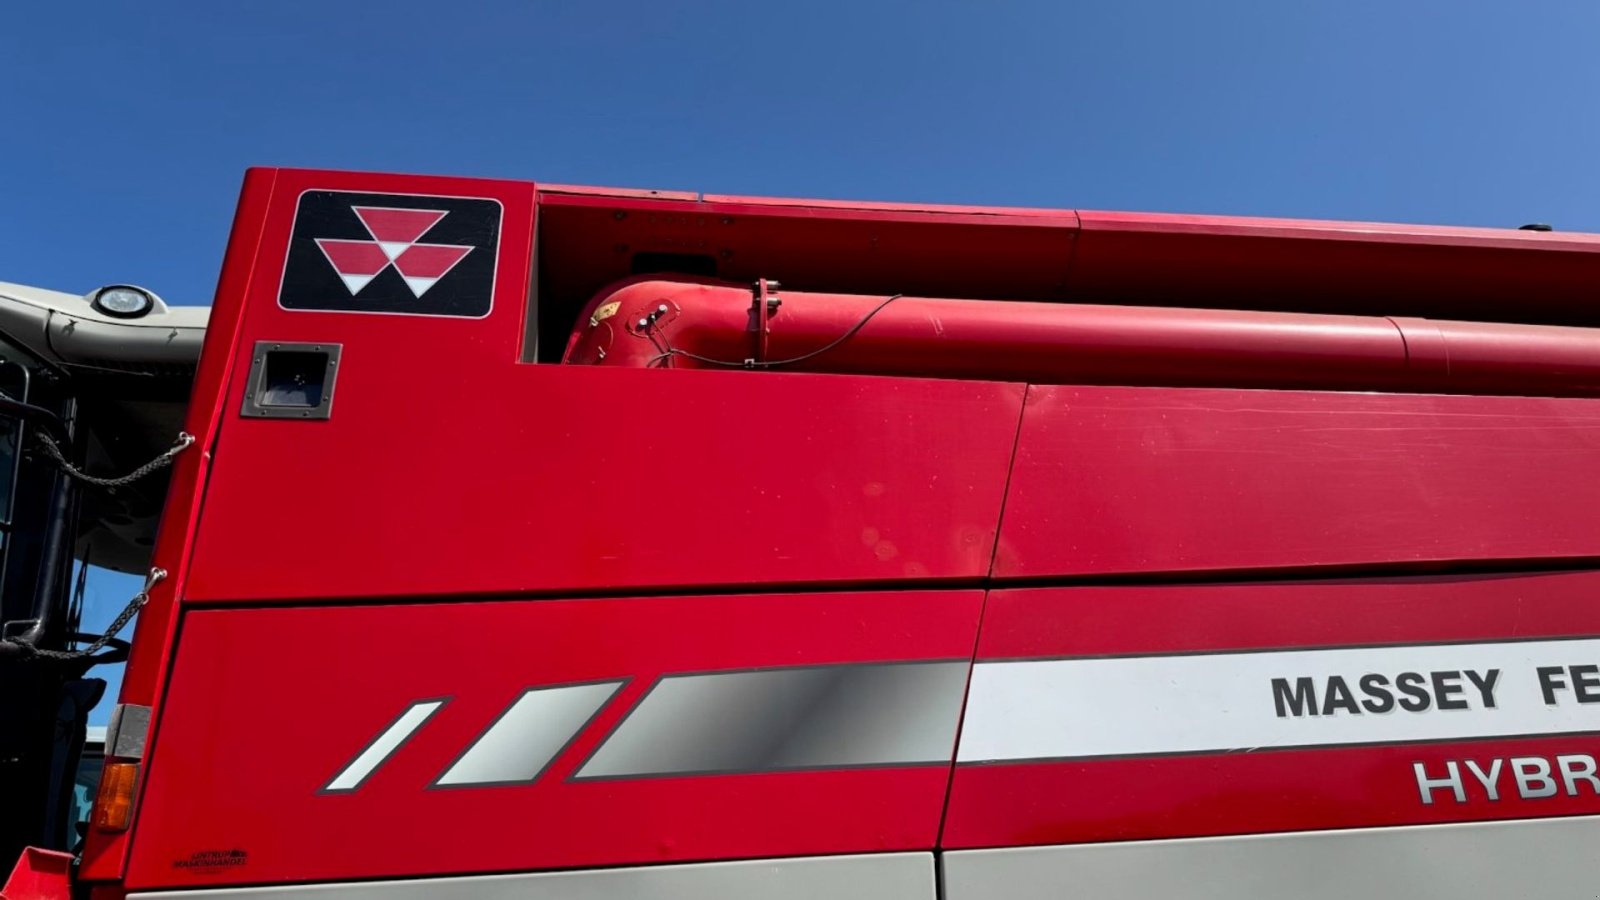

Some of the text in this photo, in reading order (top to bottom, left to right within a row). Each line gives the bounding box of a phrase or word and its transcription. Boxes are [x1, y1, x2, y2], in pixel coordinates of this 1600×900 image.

[1271, 664, 1600, 718] MASSEY FE
[1413, 754, 1600, 805] HYBR
